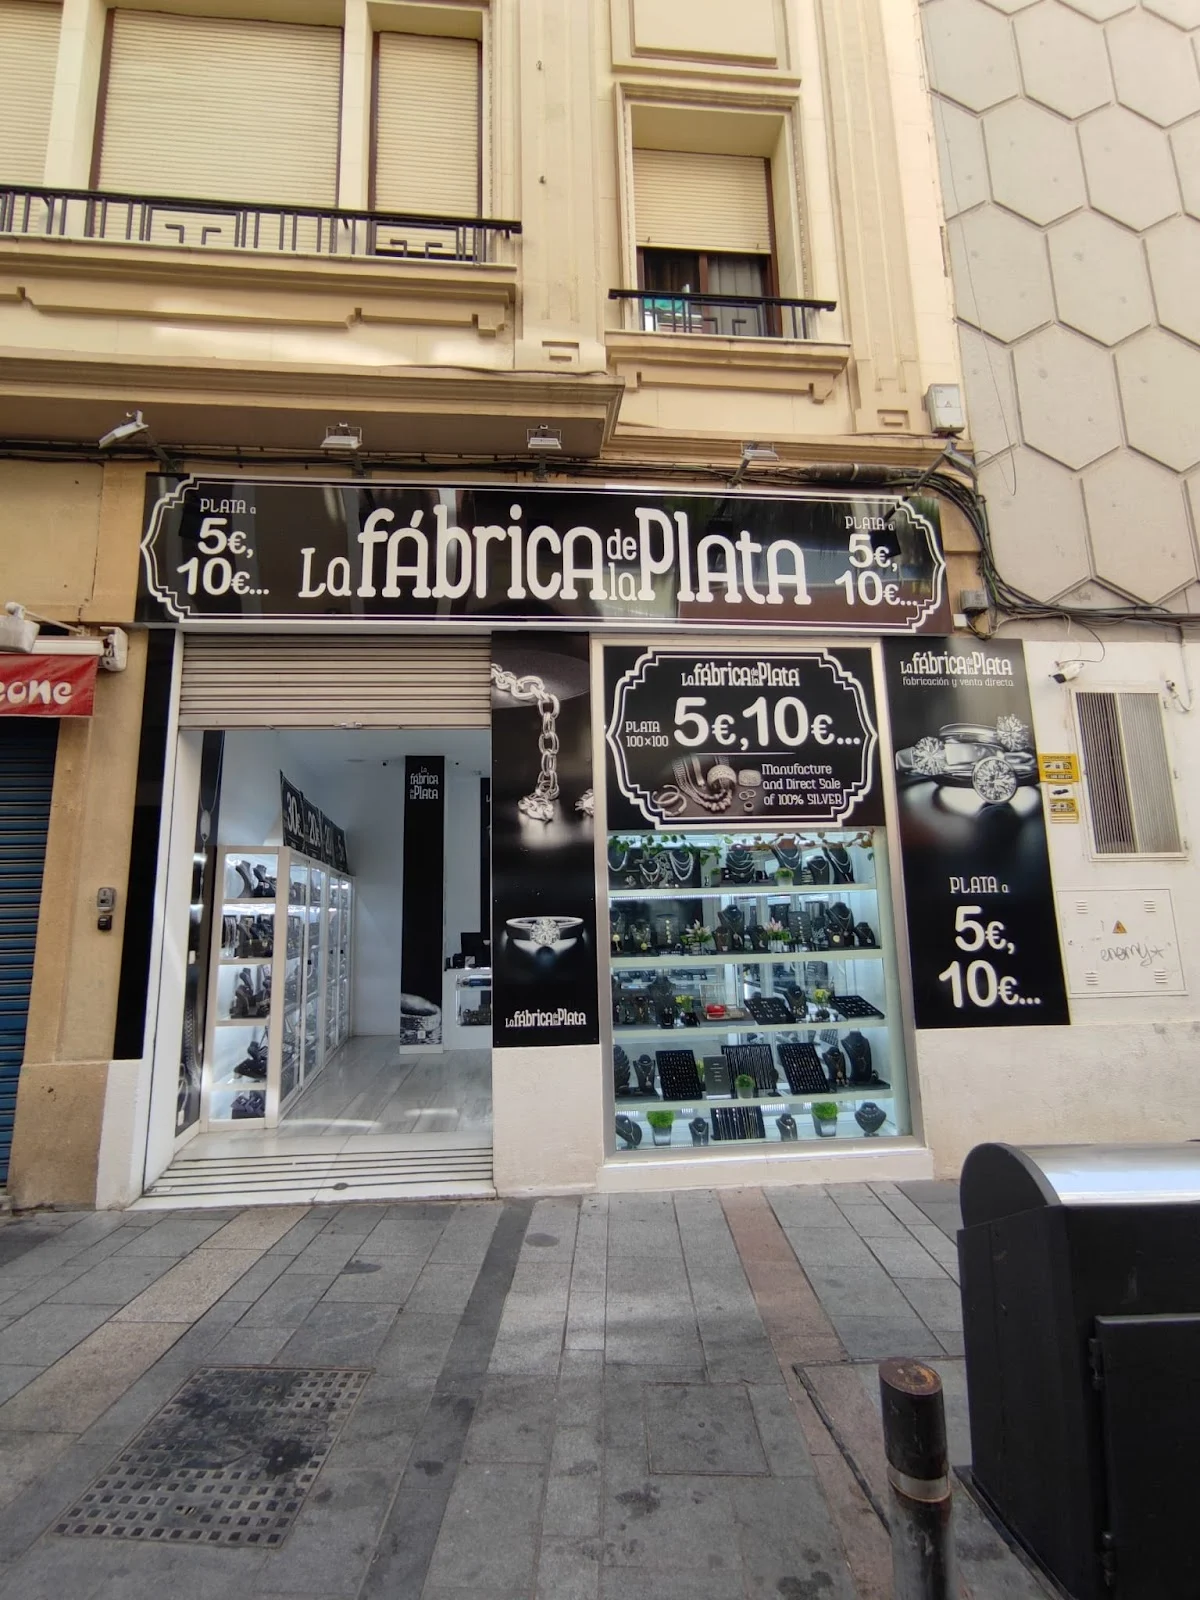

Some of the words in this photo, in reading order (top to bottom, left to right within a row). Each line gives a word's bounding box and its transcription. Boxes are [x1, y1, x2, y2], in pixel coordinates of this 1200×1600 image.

[200, 498, 247, 515] PLATA
[845, 516, 885, 531] PLATA
[198, 517, 254, 558] 5€,
[607, 528, 637, 561] de
[357, 504, 607, 600] fábrica
[635, 507, 812, 605] Plata
[848, 534, 898, 573] 5€,
[298, 547, 352, 598] La
[608, 563, 637, 602] la
[681, 672, 694, 686] La
[694, 661, 752, 687] fábrica
[757, 661, 800, 687] Plata
[900, 660, 913, 675] La
[911, 651, 967, 675] fábrica
[971, 651, 1014, 676] Plata
[0, 680, 73, 705] one
[902, 676, 949, 686] fabricación
[951, 678, 957, 688] y
[960, 678, 983, 687] venta
[985, 677, 1014, 687] directa
[625, 721, 660, 733] PLATA
[761, 762, 833, 775] Manufacture
[762, 778, 784, 790] and
[785, 778, 816, 790] Direct
[818, 778, 841, 790] Sale
[763, 793, 775, 806] of
[777, 793, 805, 806] 100%
[806, 793, 843, 805] SILVER
[949, 876, 998, 894] PLATA
[1001, 883, 1009, 894] a
[954, 904, 1016, 953] 5€,
[505, 1017, 514, 1028] La
[513, 1008, 553, 1027] fábrica
[556, 1007, 587, 1026] Plata
